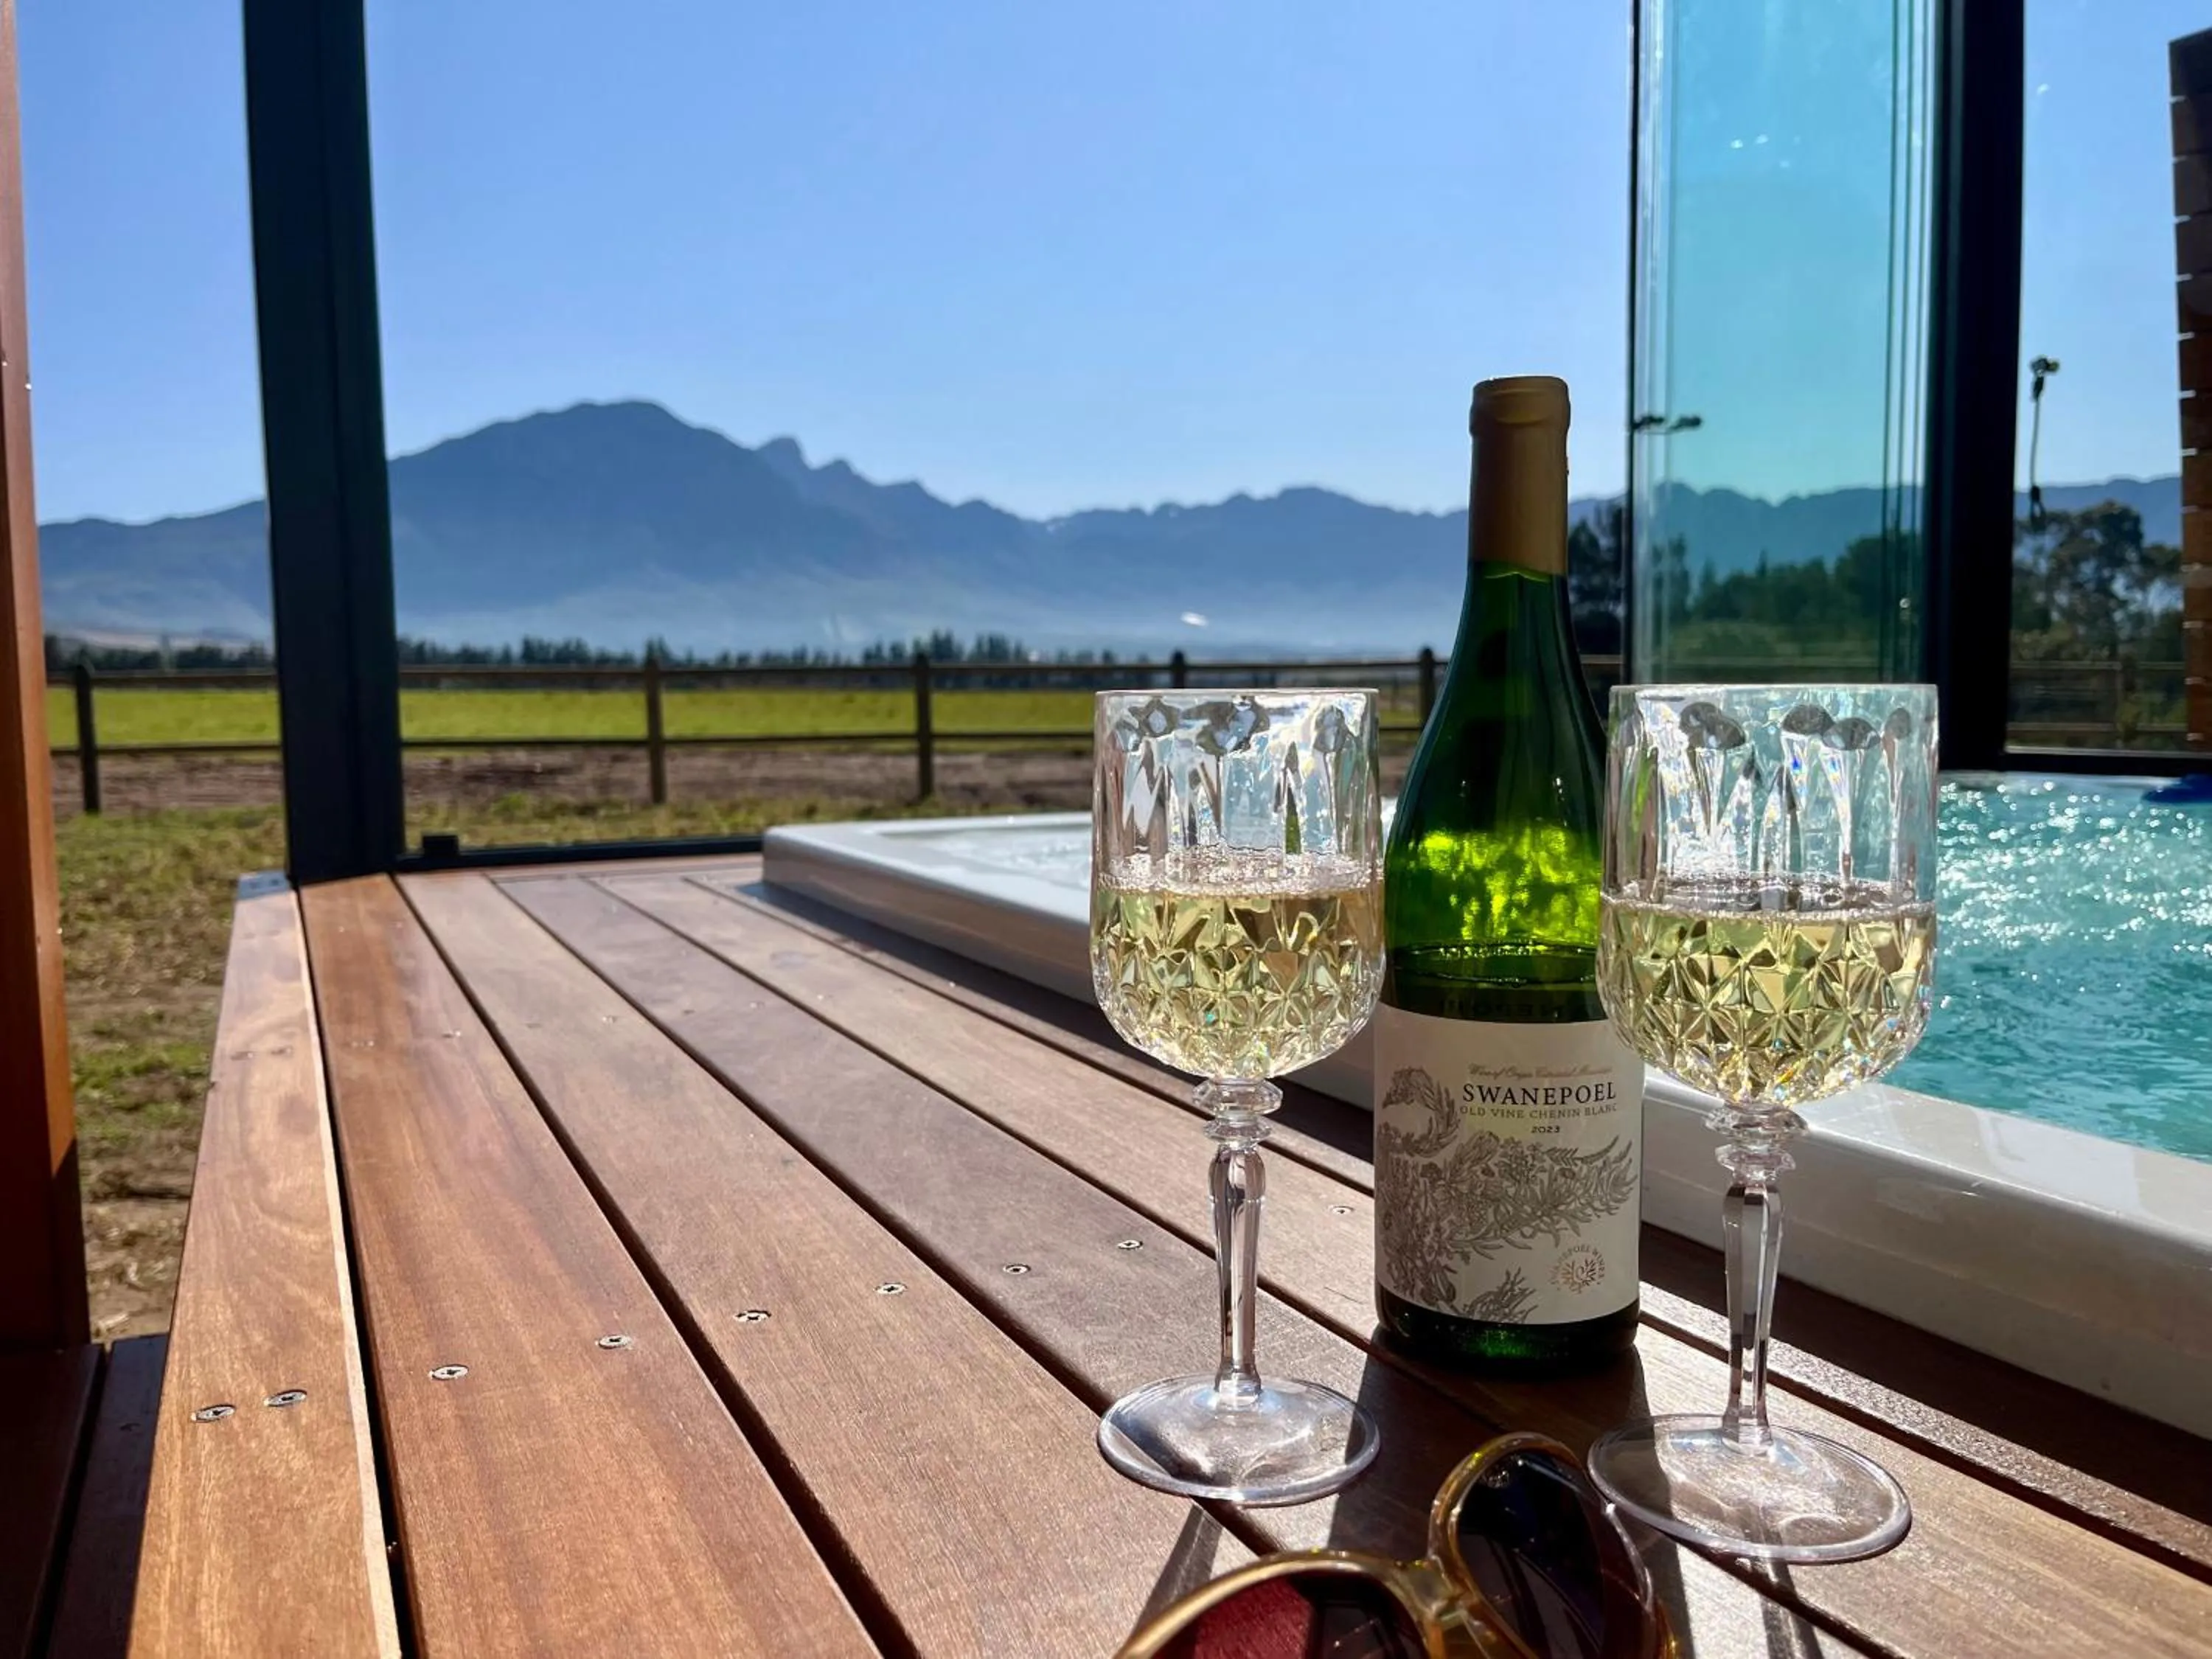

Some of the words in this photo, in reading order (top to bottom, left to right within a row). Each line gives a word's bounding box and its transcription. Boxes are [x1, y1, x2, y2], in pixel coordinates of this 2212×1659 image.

[1462, 1081, 1617, 1106] SWANEPOEL
[1460, 1105, 1486, 1118] OLD
[1489, 1107, 1525, 1119] VINE
[1528, 1107, 1581, 1119] CHENIN
[1584, 1102, 1618, 1117] BLANC
[1531, 1125, 1560, 1134] 2023
